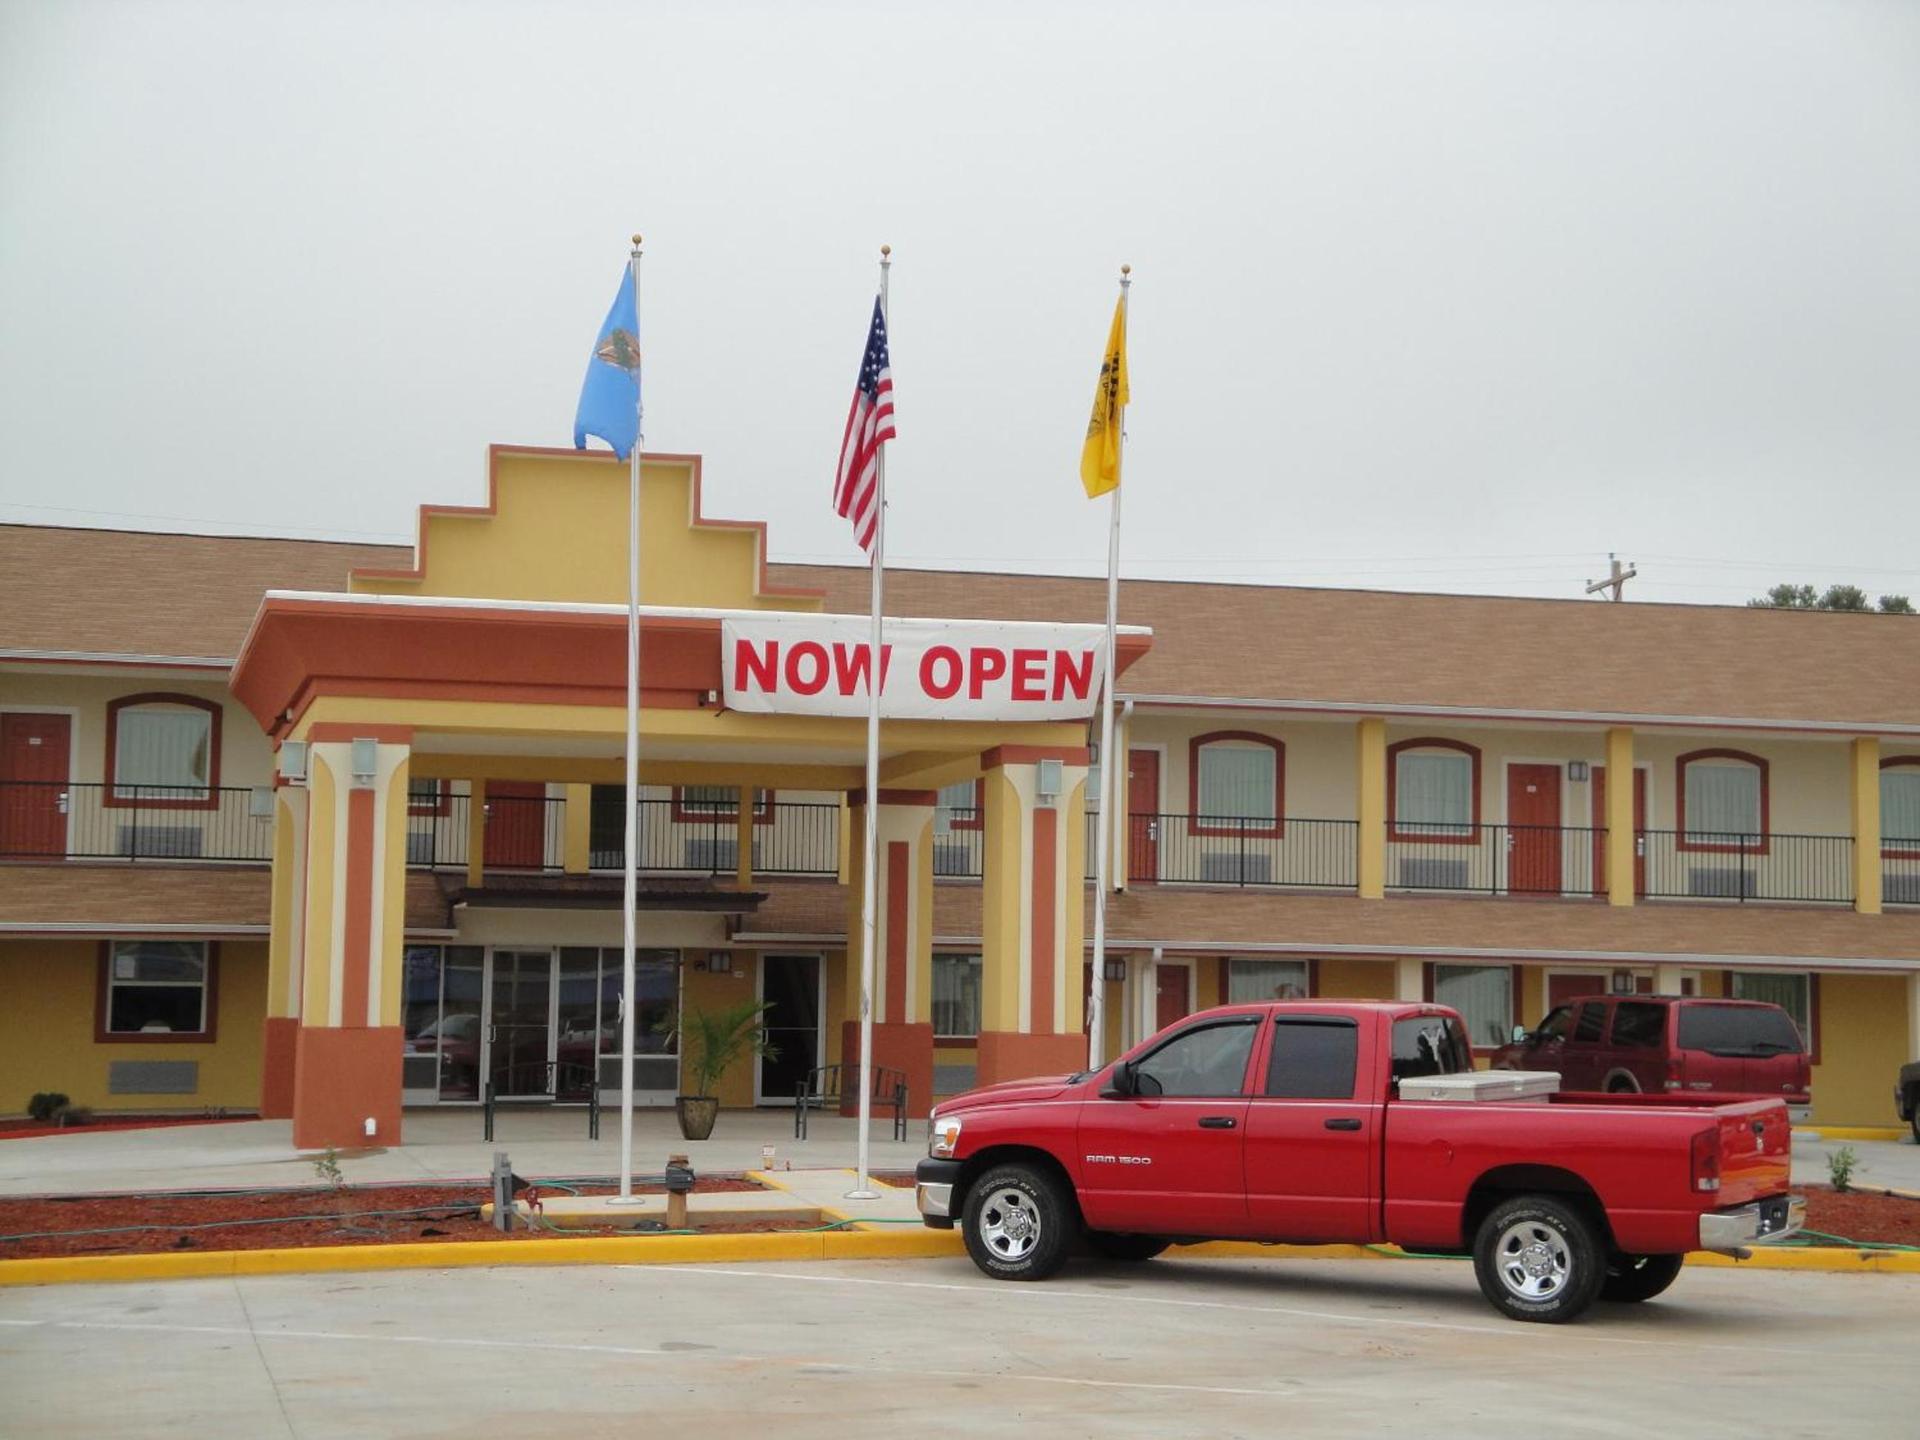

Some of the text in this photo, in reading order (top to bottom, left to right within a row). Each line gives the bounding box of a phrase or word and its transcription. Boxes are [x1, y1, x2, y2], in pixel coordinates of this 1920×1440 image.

[734, 639, 1094, 701] NOW OPEN
[1086, 1155, 1152, 1165] RAM 1500
